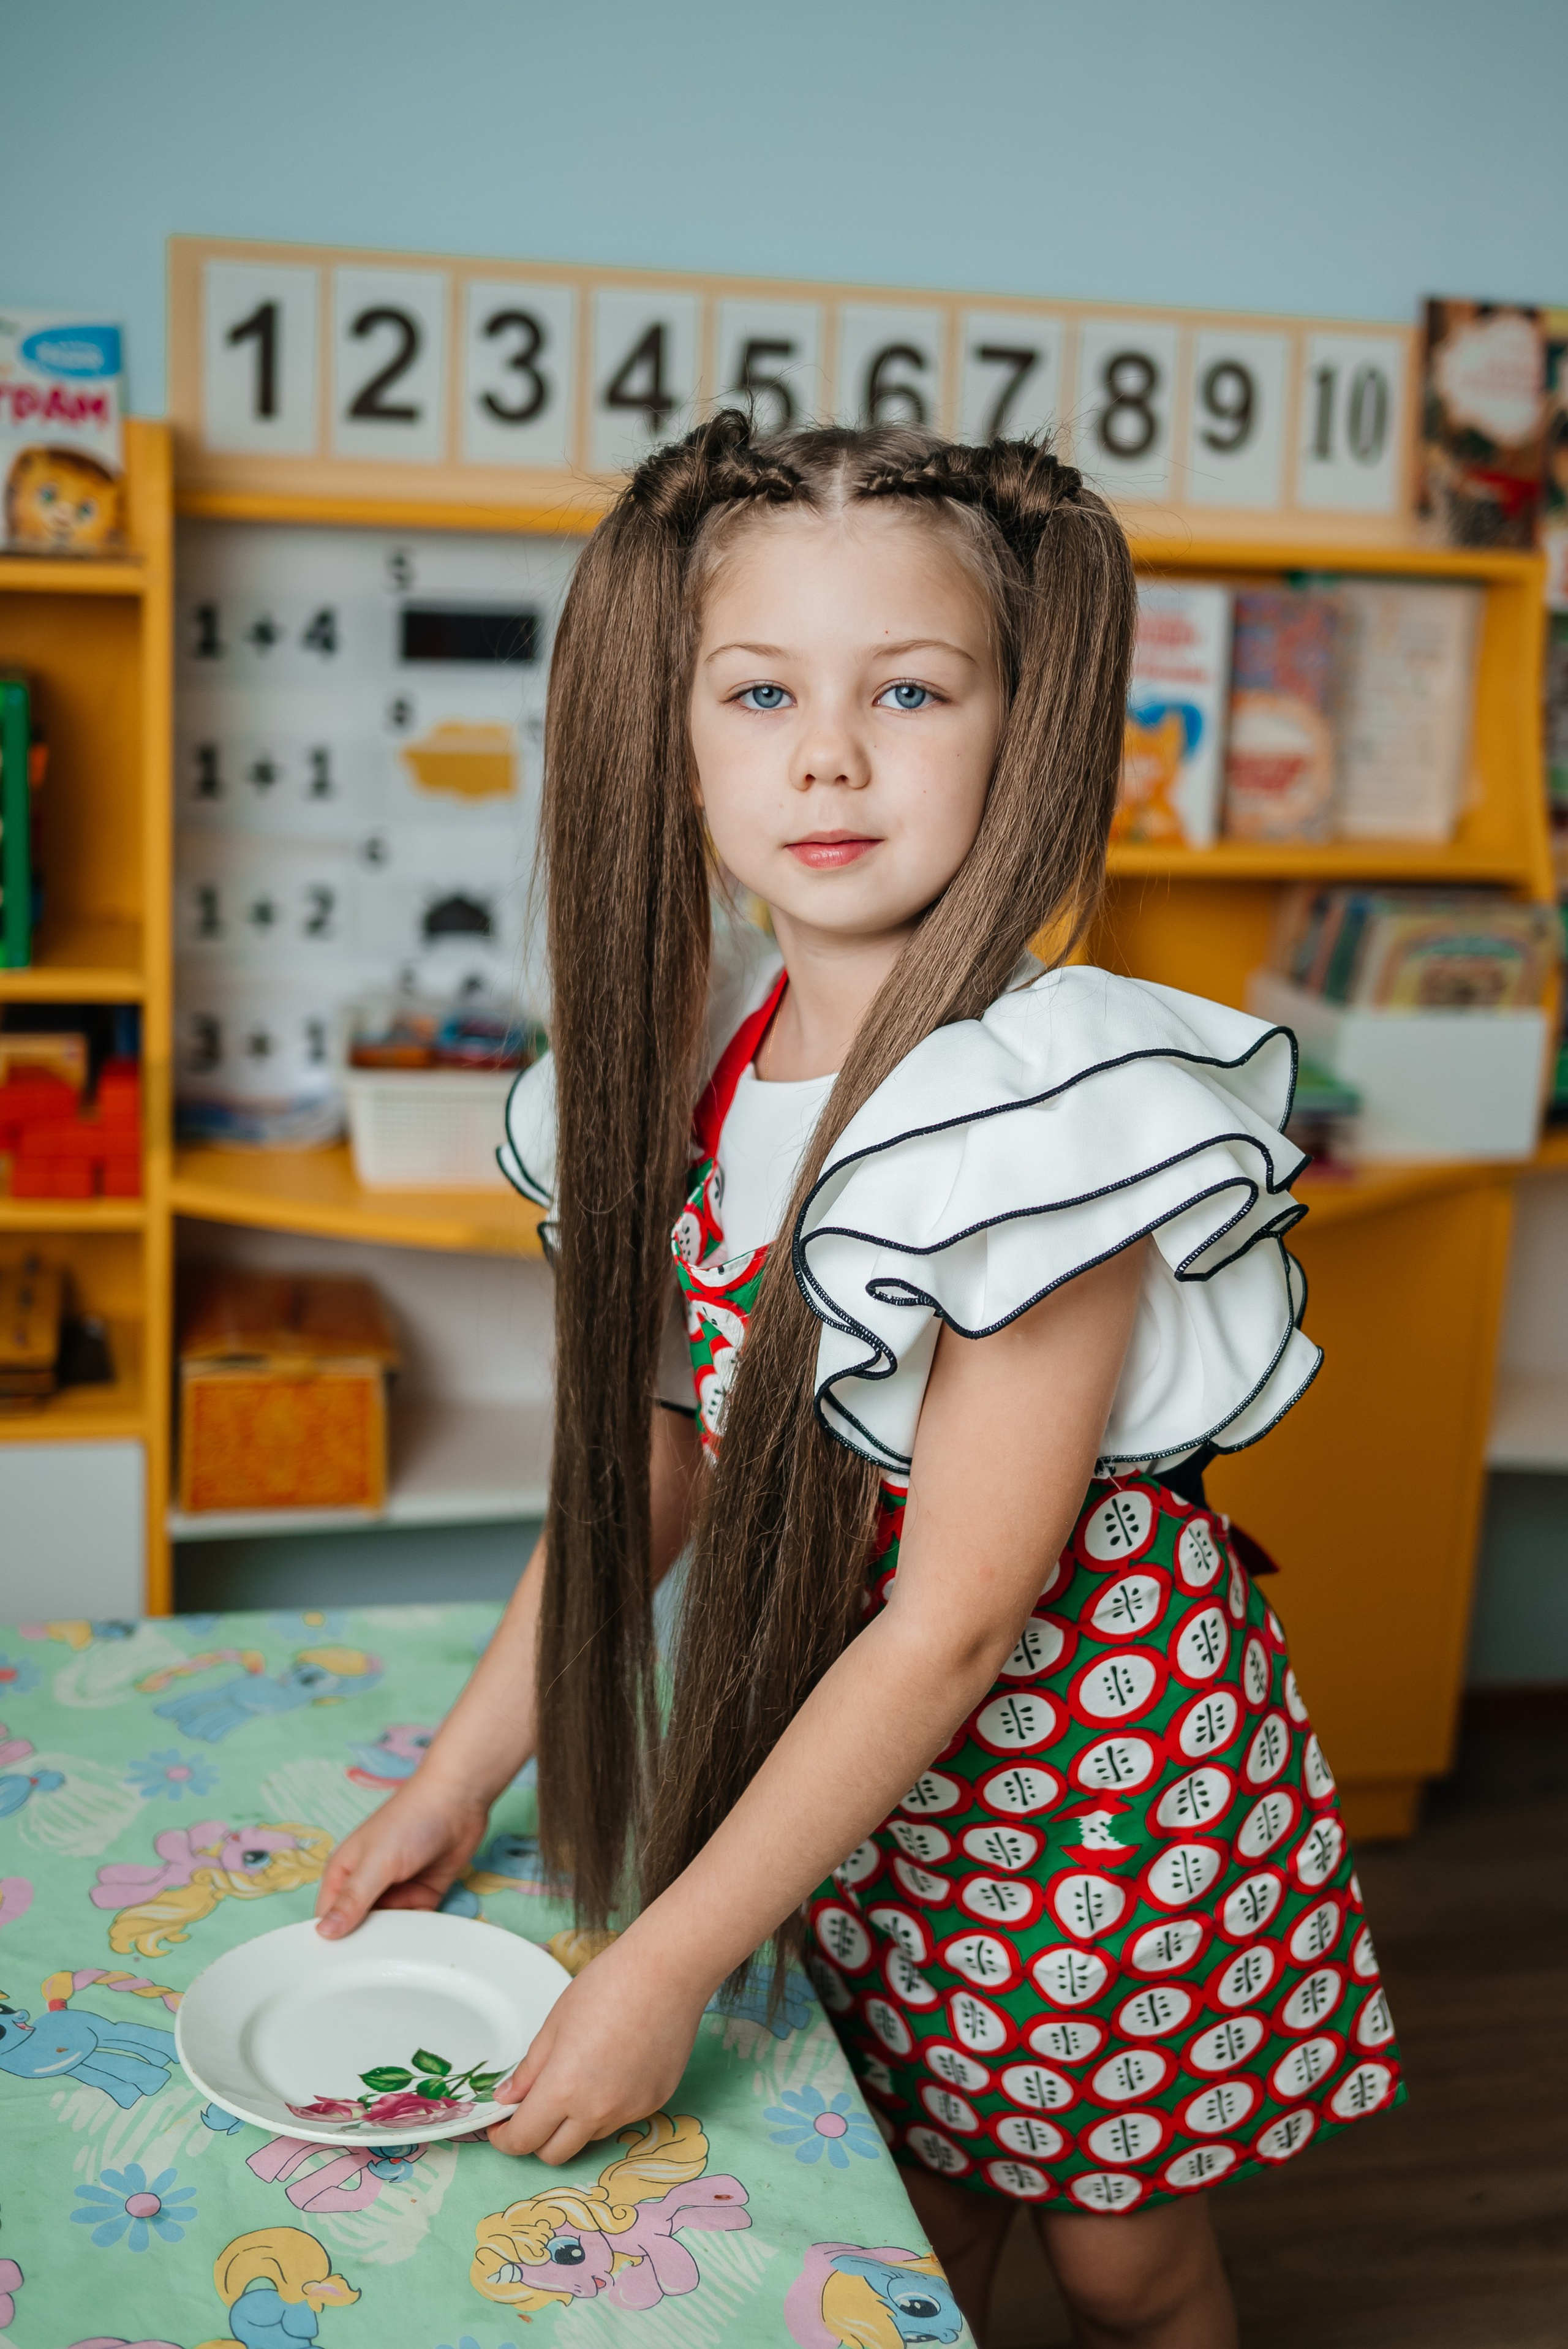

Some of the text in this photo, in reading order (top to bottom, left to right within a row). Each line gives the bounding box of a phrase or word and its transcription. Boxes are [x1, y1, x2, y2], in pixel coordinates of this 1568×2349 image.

[227, 299, 1390, 464] 1 2 3 4 5 6 7 8 9 10
